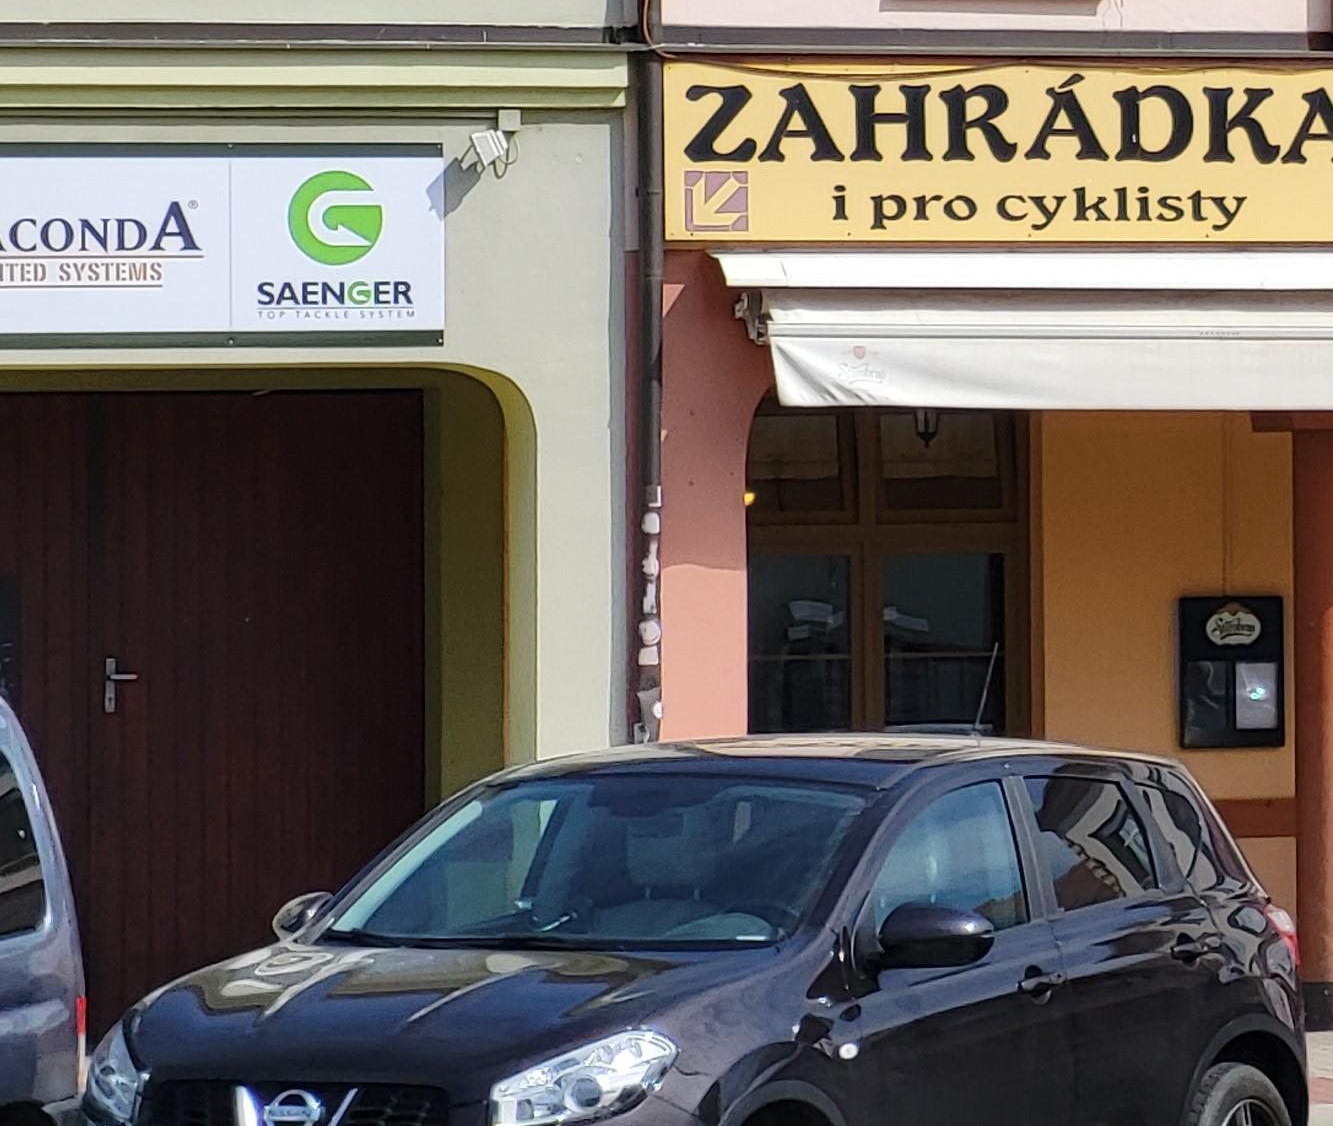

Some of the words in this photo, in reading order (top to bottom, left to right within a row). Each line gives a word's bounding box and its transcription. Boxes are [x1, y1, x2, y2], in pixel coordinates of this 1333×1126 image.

[831, 184, 849, 222] i
[869, 192, 978, 231] pro
[995, 183, 1249, 232] cyklisty
[0, 201, 202, 253] CONDA
[58, 262, 162, 282] SYSTEMS
[257, 281, 413, 306] SAENGER
[258, 310, 286, 320] TOP
[296, 310, 350, 320] TACKLE
[359, 310, 415, 319] SYSTEM
